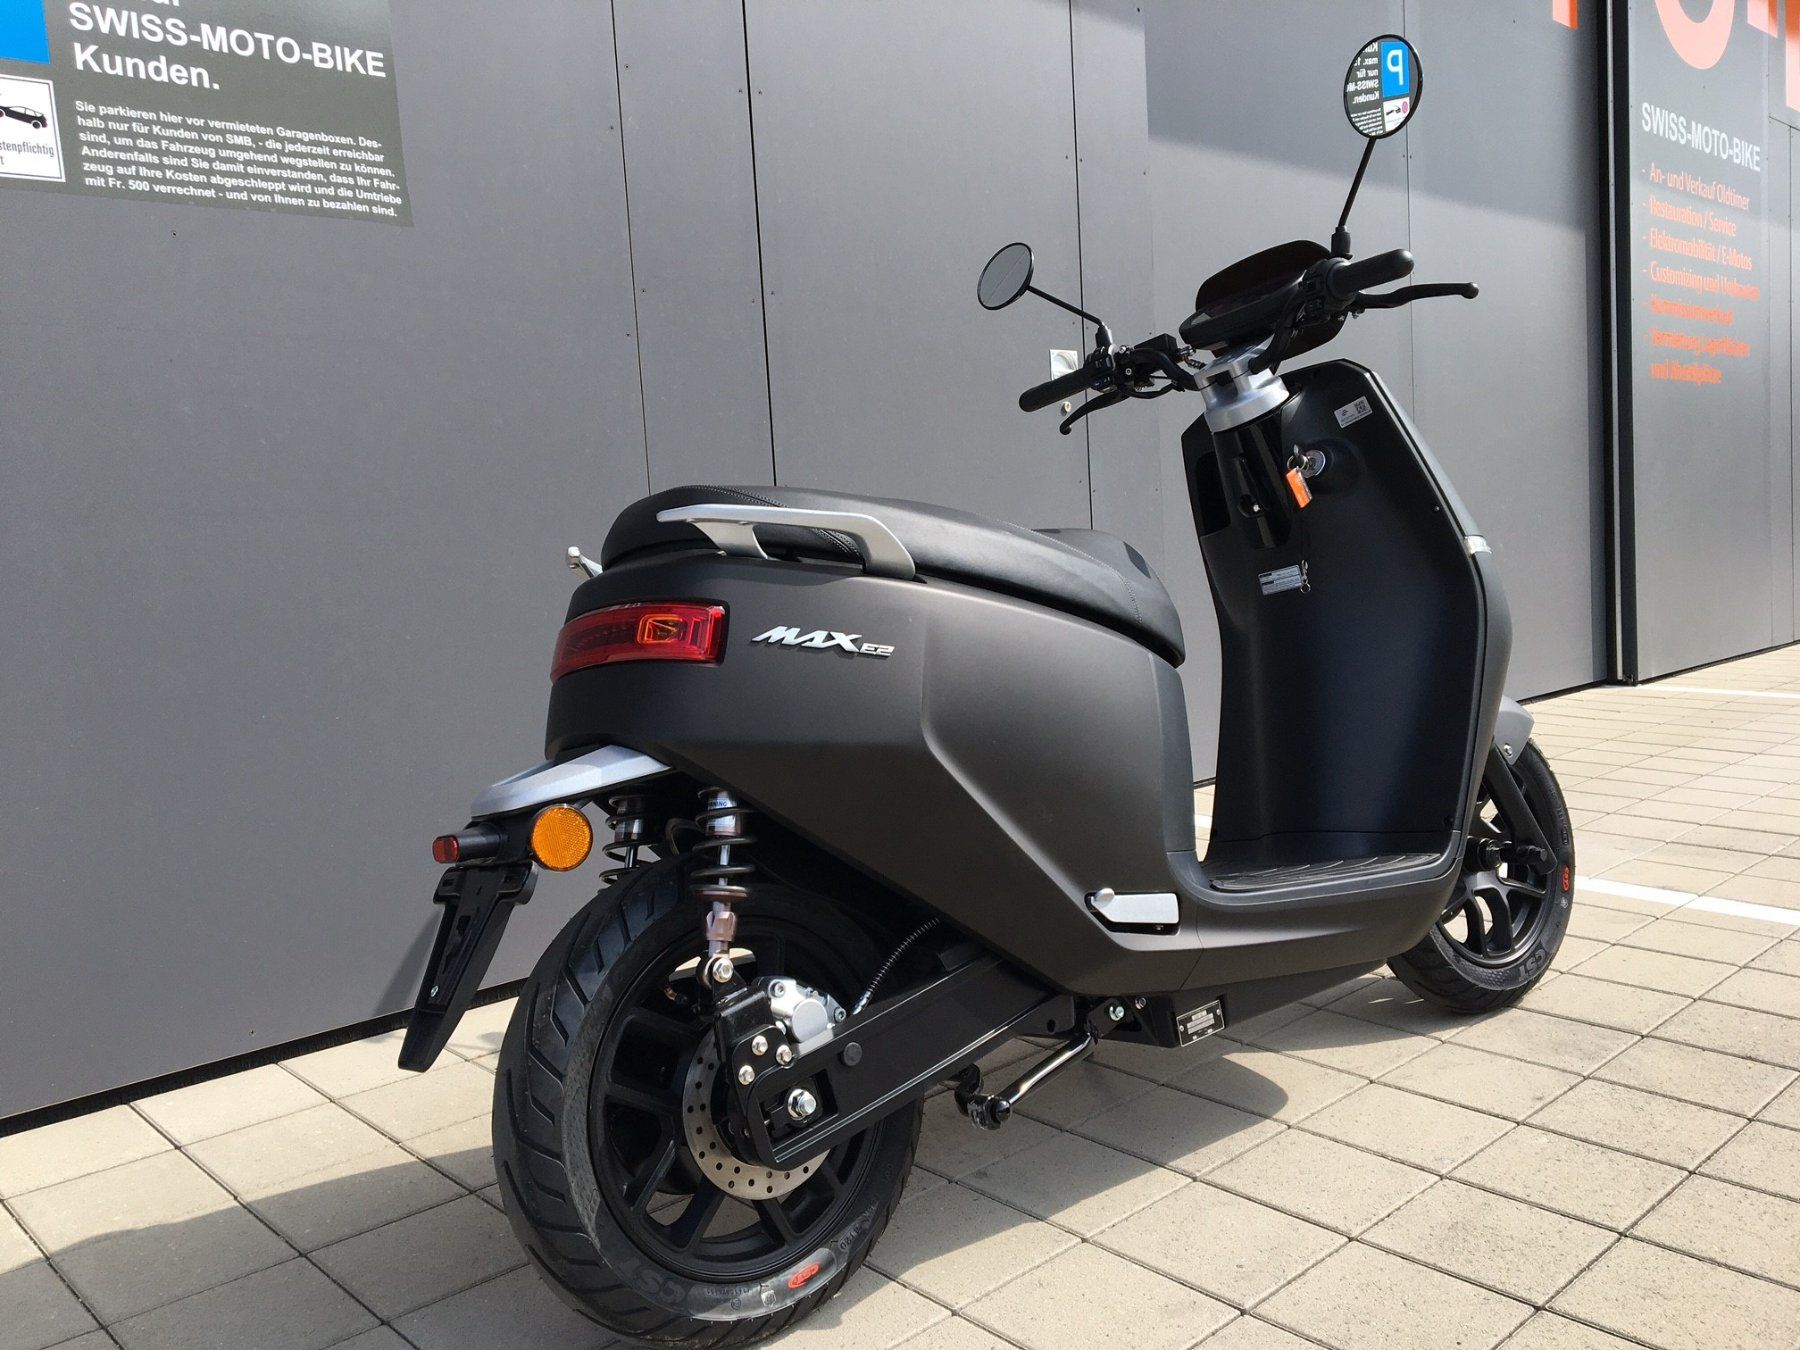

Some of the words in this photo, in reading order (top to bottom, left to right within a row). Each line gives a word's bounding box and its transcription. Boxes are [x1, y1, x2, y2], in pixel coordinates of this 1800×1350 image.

[70, 2, 387, 78] SWISS-MOTO-BIKE
[73, 42, 220, 90] Kunden.
[75, 100, 96, 112] Sie
[100, 104, 157, 120] parkieren
[160, 111, 184, 124] hier
[186, 116, 205, 126] vor
[208, 118, 274, 136] vermieteten
[276, 126, 357, 146] Garagenboxen.
[358, 136, 382, 148] Des-
[77, 115, 105, 128] halb
[108, 120, 130, 132] nur
[132, 122, 150, 134] für
[152, 125, 199, 140] Kunden
[201, 132, 224, 143] von
[226, 134, 256, 148] SMB,
[265, 139, 283, 150] die
[284, 141, 331, 154] jederzeit
[332, 148, 384, 162] erreichbar
[1641, 102, 1761, 173] SWISS-MOTO-BIKE
[79, 131, 111, 145] sind,
[114, 136, 134, 147] um
[136, 137, 158, 150] das
[161, 140, 216, 158] Fahrzeug
[218, 148, 278, 163] umgehend
[280, 155, 338, 170] wegstellen
[339, 162, 352, 172] zu
[354, 163, 395, 178] können.
[81, 146, 160, 164] Anderenfalls
[162, 156, 188, 168] sind
[190, 158, 210, 170] Sie
[212, 160, 246, 174] damit
[247, 165, 328, 183] einverstanden,
[329, 173, 355, 185] dass
[356, 175, 372, 187] Ihr
[373, 178, 400, 191] Fahr-
[83, 162, 114, 176] zeug
[116, 165, 136, 176] auf
[138, 167, 163, 179] Ihre
[166, 170, 208, 184] Kosten
[210, 174, 286, 192] abgeschleppt
[288, 182, 312, 194] wird
[314, 184, 335, 196] und
[337, 187, 354, 198] die
[356, 189, 402, 205] Umtriebe
[85, 176, 106, 188] mit
[108, 178, 126, 190] Fr.
[128, 180, 150, 192] 500
[152, 184, 216, 198] verrechnet
[226, 190, 248, 201] und
[250, 193, 272, 204] von
[274, 194, 305, 208] Ihnen
[307, 198, 320, 208] zu
[322, 199, 370, 214] bezahlen
[371, 206, 398, 217] sind.
[1650, 161, 1666, 184] An-
[1667, 170, 1684, 191] und
[1685, 171, 1716, 200] Verkauf
[752, 625, 862, 653] MAX
